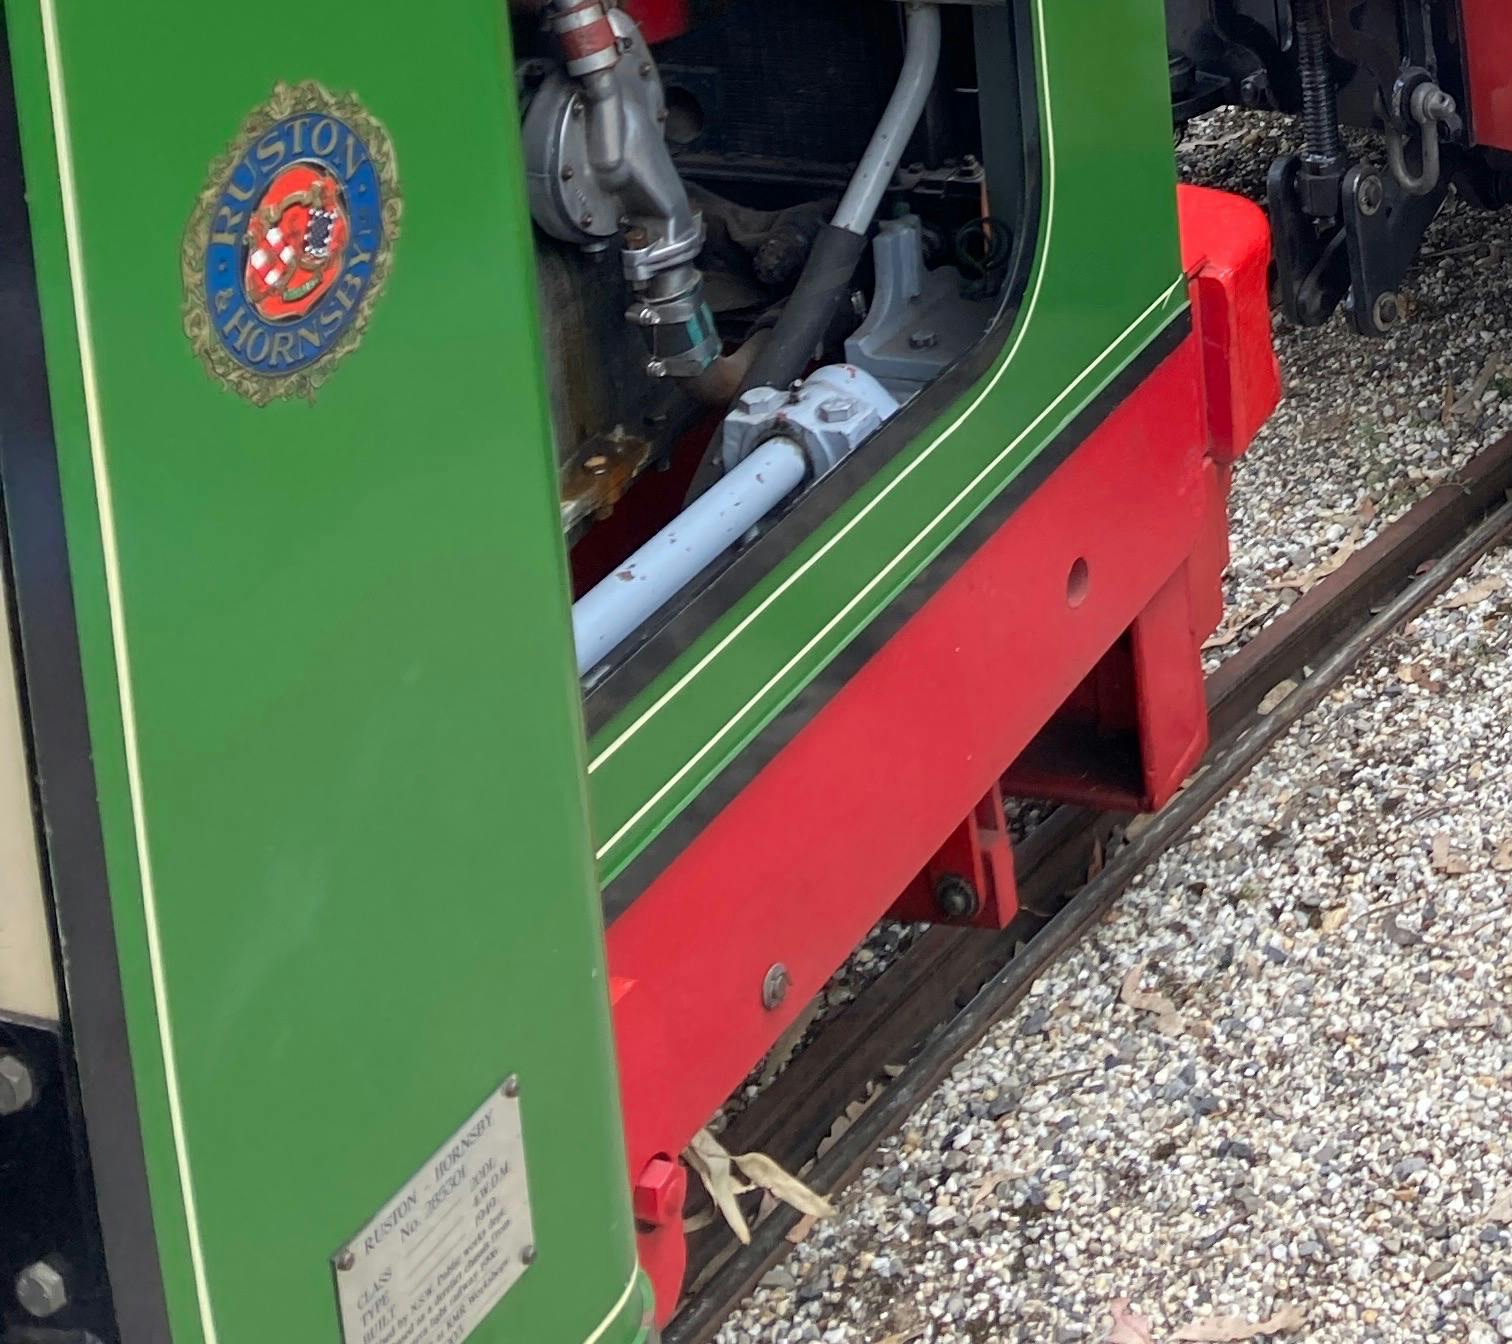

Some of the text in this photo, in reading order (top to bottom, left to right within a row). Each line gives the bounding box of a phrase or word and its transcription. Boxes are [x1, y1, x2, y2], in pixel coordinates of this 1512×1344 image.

[211, 118, 370, 247] RUSTON
[222, 243, 373, 367] HORNSBY
[363, 1191, 417, 1255] RUSTON
[434, 1112, 493, 1180] HORNSBY
